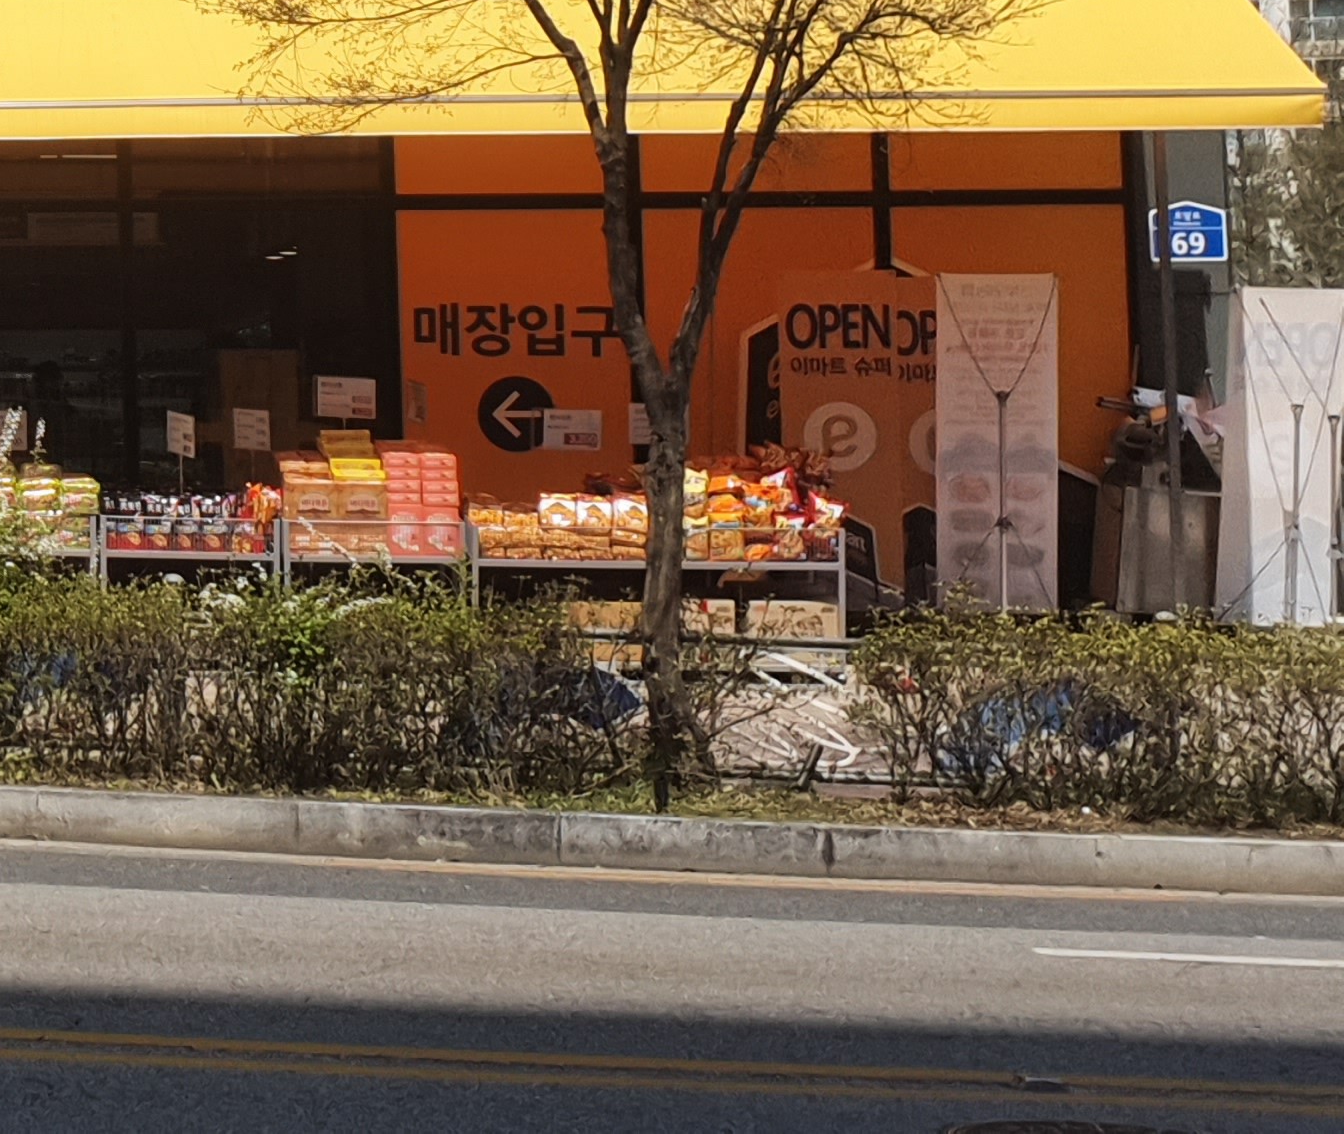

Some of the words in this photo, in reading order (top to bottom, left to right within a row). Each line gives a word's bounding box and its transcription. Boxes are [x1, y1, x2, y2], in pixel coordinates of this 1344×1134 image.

[1171, 231, 1206, 256] 69
[412, 300, 621, 358] 매장입구
[785, 302, 892, 351] OPEN
[790, 356, 848, 378] 이마트
[853, 355, 892, 378] 슈퍼
